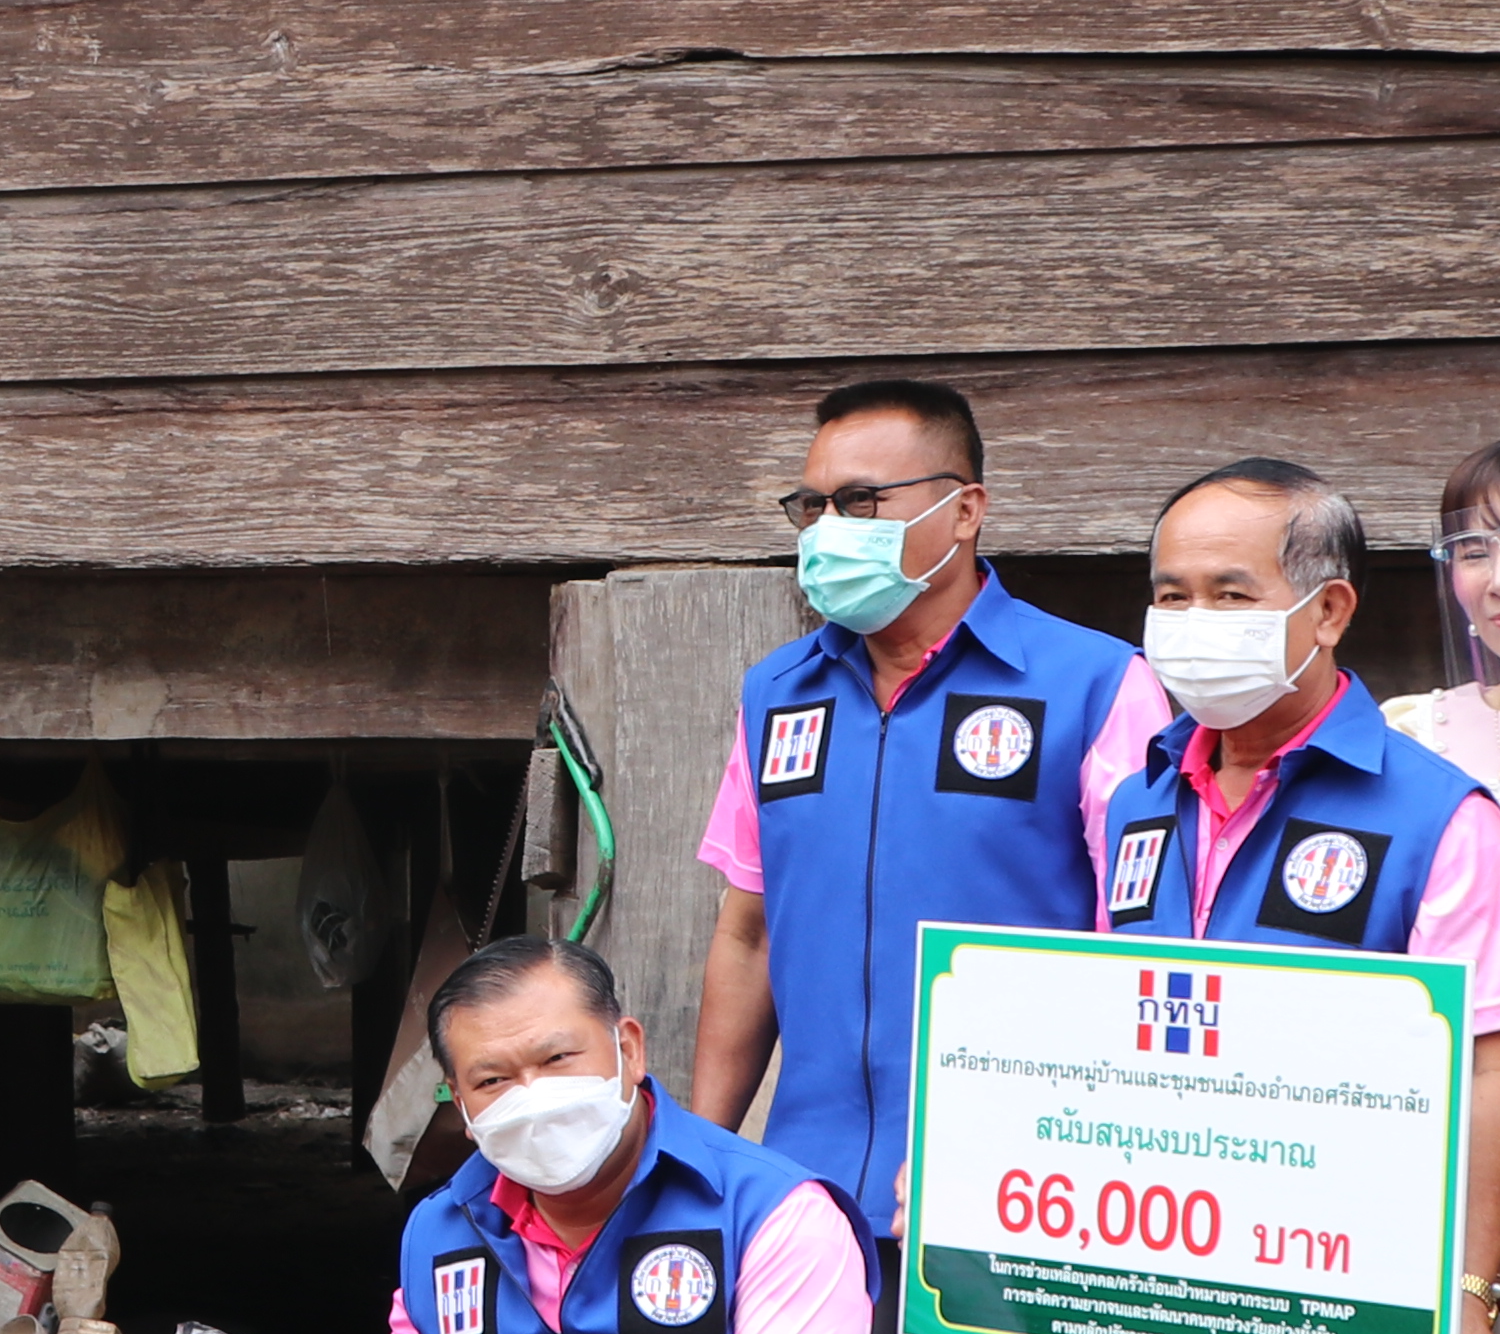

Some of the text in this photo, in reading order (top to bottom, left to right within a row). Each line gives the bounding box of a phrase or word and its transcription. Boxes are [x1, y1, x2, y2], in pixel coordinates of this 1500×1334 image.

[1137, 996, 1220, 1029] กทบ
[940, 1047, 1431, 1115] เครือข่ายกองทุนหมู่บ้านและชุมชนเมืองอำเภอศรีสัชนาลัย
[1035, 1107, 1317, 1170] สนับสนุนงบประมาณ
[996, 1168, 1351, 1274] 66,000 บาท
[1299, 1298, 1357, 1322] TPMAP
